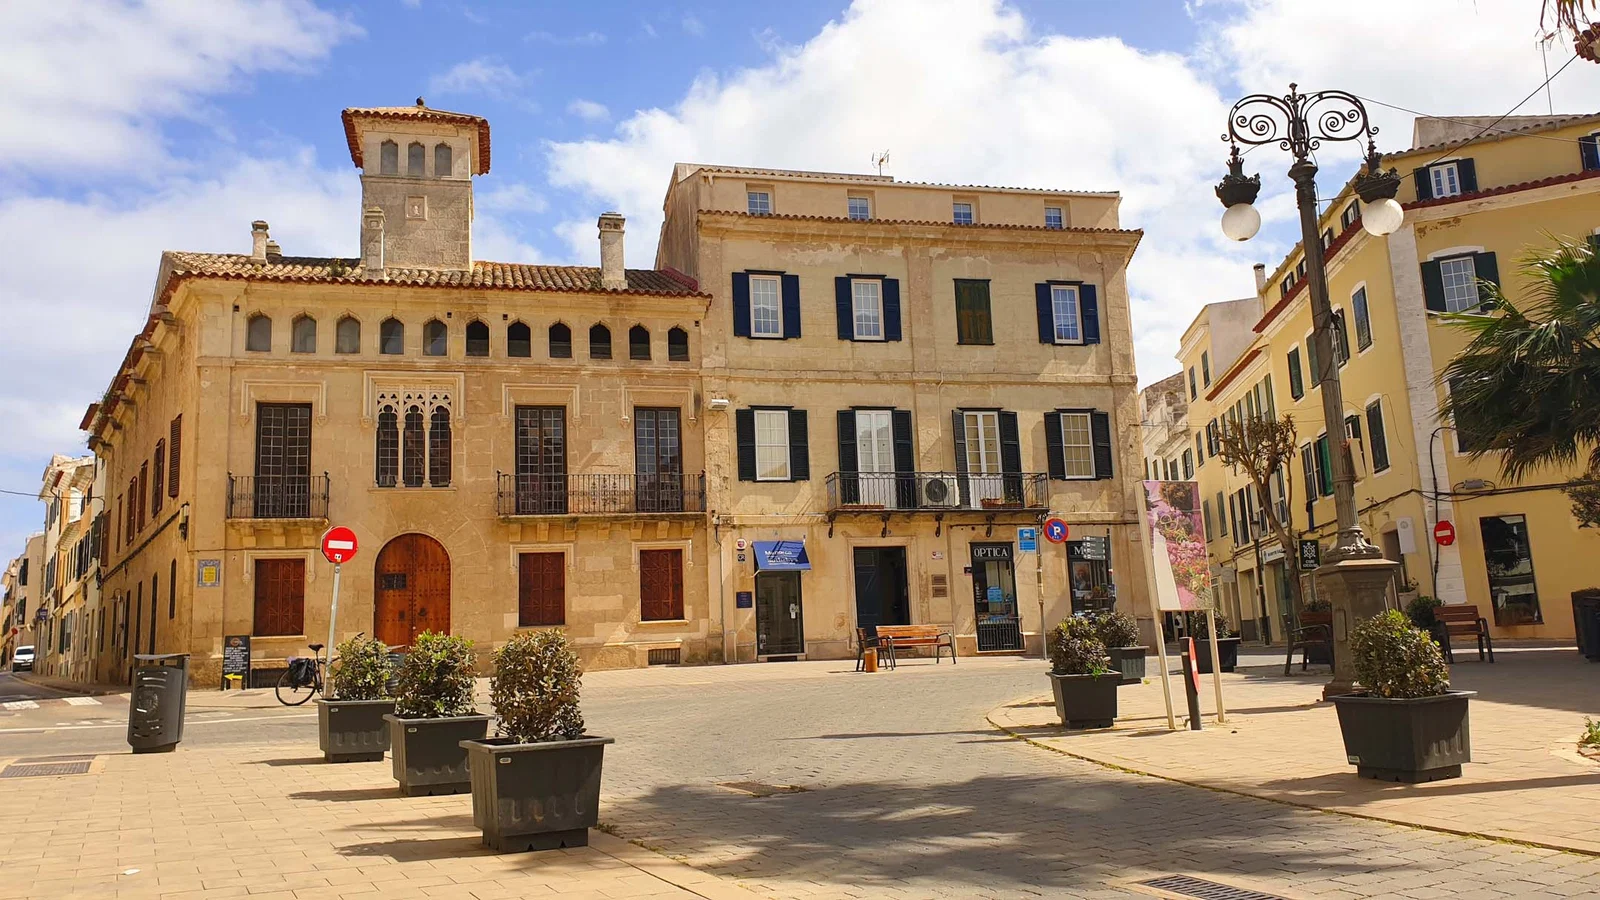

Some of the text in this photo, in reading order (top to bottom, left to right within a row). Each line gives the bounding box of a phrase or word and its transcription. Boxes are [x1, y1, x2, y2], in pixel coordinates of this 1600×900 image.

[1053, 526, 1061, 536] P
[974, 548, 1008, 557] OPTICA
[1074, 545, 1084, 555] M
